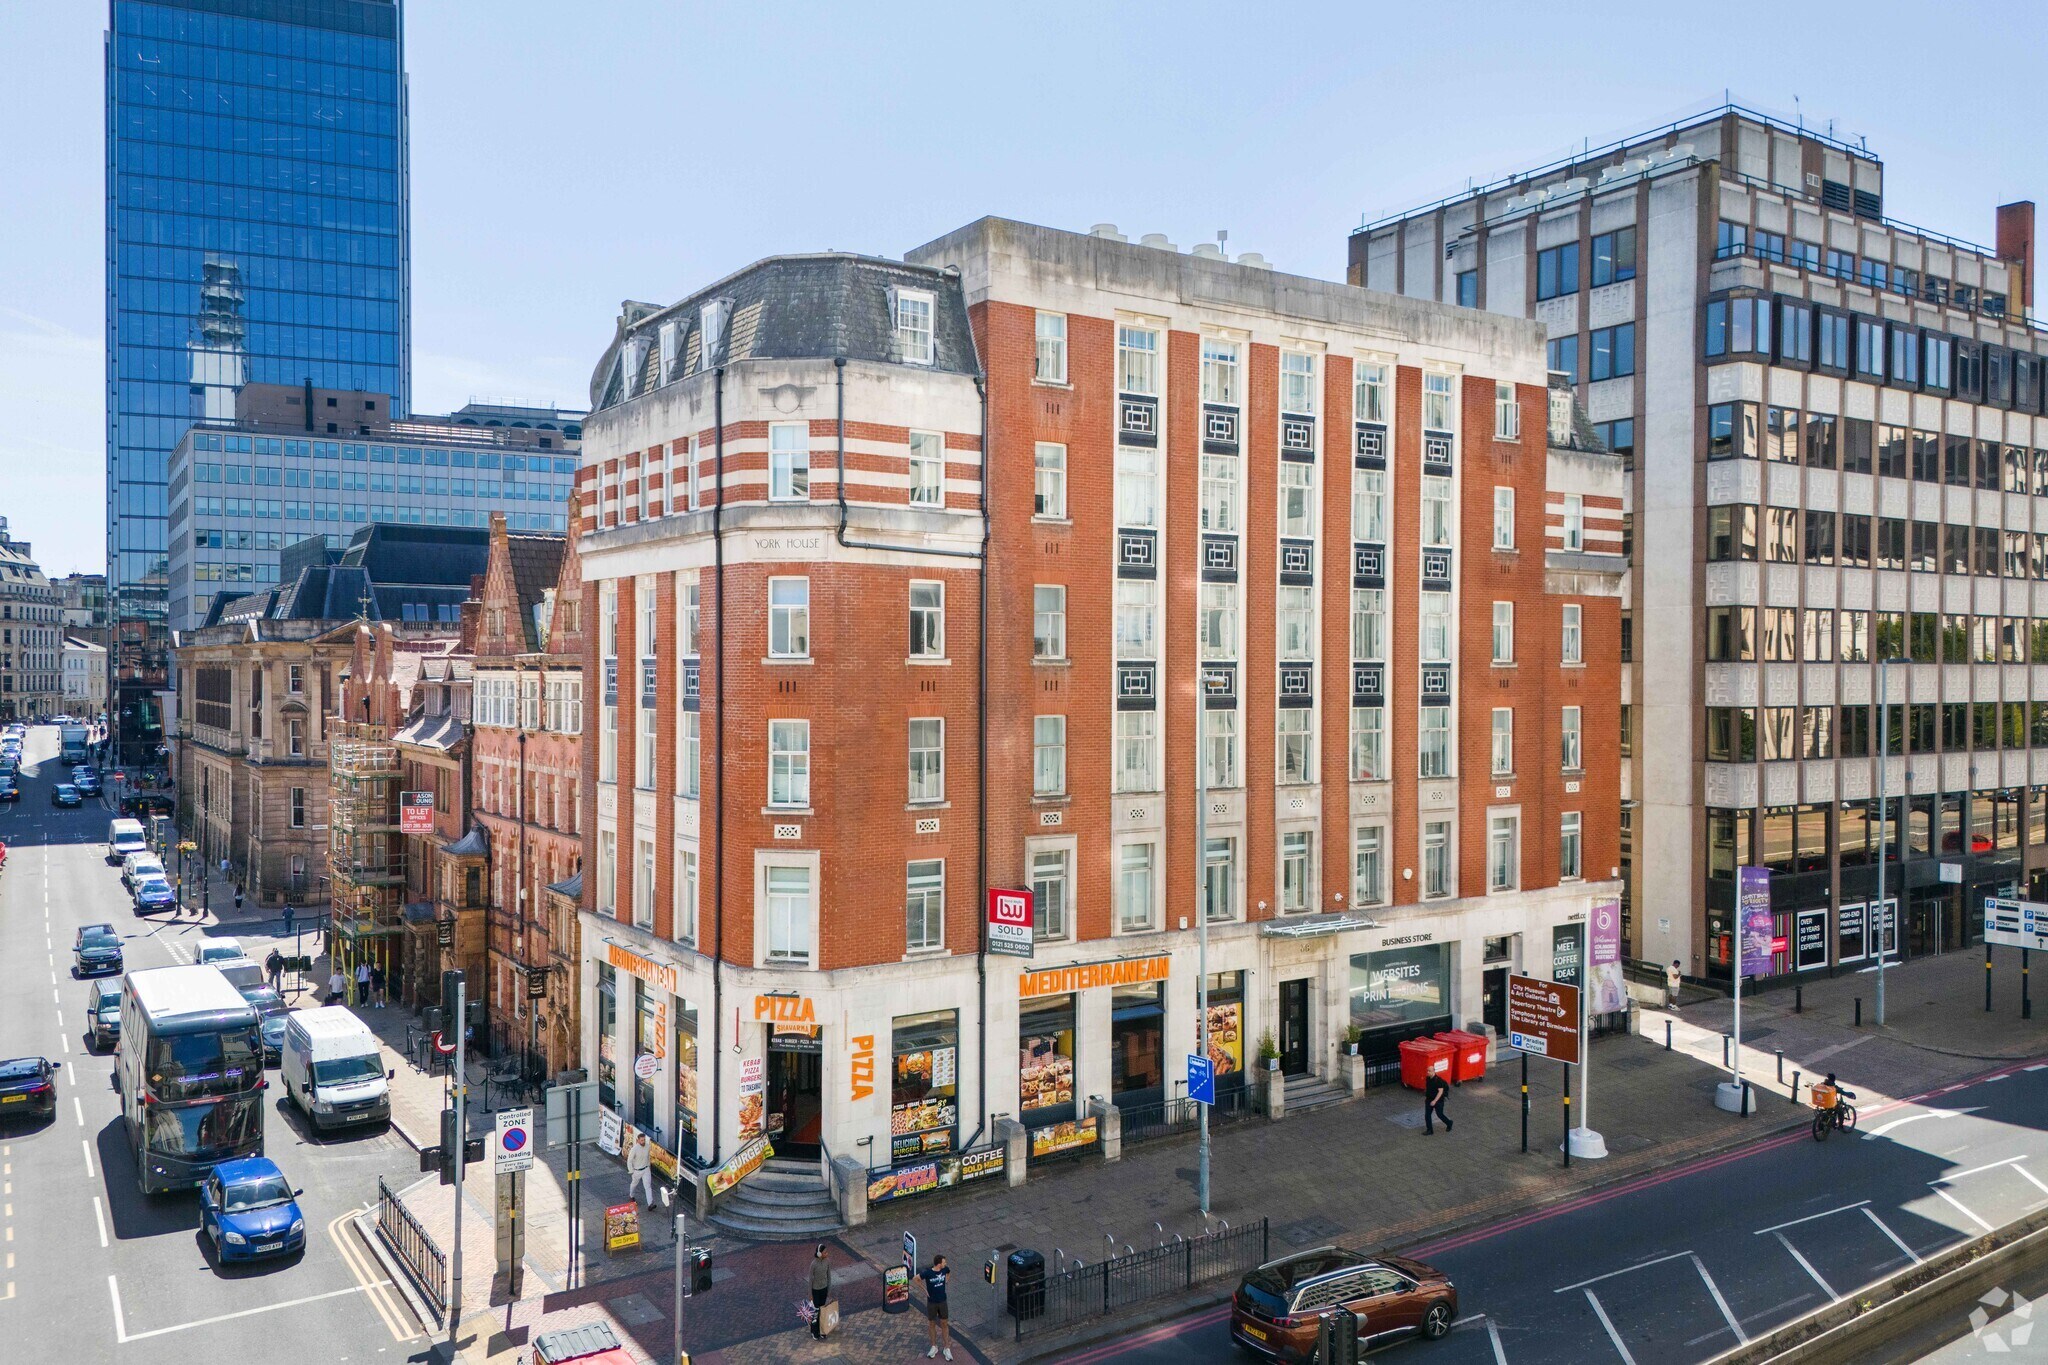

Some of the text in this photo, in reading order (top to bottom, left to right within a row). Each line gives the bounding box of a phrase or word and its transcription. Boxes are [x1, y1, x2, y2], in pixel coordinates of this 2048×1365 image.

[754, 538, 820, 548] YORK HOUSE
[1806, 924, 1820, 932] YEARS
[1840, 919, 1858, 928] PRINTING
[998, 925, 1024, 936] SOLD
[1840, 927, 1860, 936] FINISHING
[1382, 933, 1432, 946] BUSINESS STORE
[1556, 942, 1574, 952] MEET
[1800, 941, 1823, 950] EXPERTISE
[1554, 954, 1578, 966] COFFEE
[609, 944, 676, 992] MEDITERRANEAN
[1372, 964, 1420, 982] WEBSITES
[1556, 968, 1574, 978] IDEAS
[1020, 957, 1170, 997] MEDITERRANEAN
[1364, 988, 1392, 1004] PRINT
[1401, 982, 1429, 995] SIGNS
[1524, 986, 1546, 995] Museum
[1525, 993, 1548, 1002] Galleries
[755, 996, 816, 1022] PIZZA
[1511, 999, 1556, 1013] Repertory Theatre
[1511, 1008, 1536, 1019] Symphony
[654, 1001, 666, 1058] PIZZA
[1521, 1017, 1538, 1026] Library
[1546, 1022, 1576, 1034] Birmingham
[1523, 1036, 1544, 1046] Paradise
[1526, 1043, 1542, 1051] Circus
[743, 1059, 761, 1067] KEBAB
[852, 1035, 874, 1102] PIZZA
[741, 1074, 762, 1083] BURGERS
[498, 1111, 531, 1120] Controlled
[504, 1119, 526, 1128] ZONE
[894, 1137, 920, 1149] DELICIOUS
[1056, 1134, 1076, 1144] PIZZA
[1056, 1140, 1082, 1150] TAKEAWAY
[730, 1133, 769, 1172] BURGERS
[894, 1146, 920, 1156] BURGERS
[962, 1147, 1004, 1166] COFFEE
[740, 1154, 764, 1176] FRIES
[898, 1163, 936, 1176] DELICIOUS
[962, 1158, 1004, 1174] SOLD HERE
[896, 1168, 938, 1190] PIZZA
[893, 1181, 938, 1197] SOLD HERE
